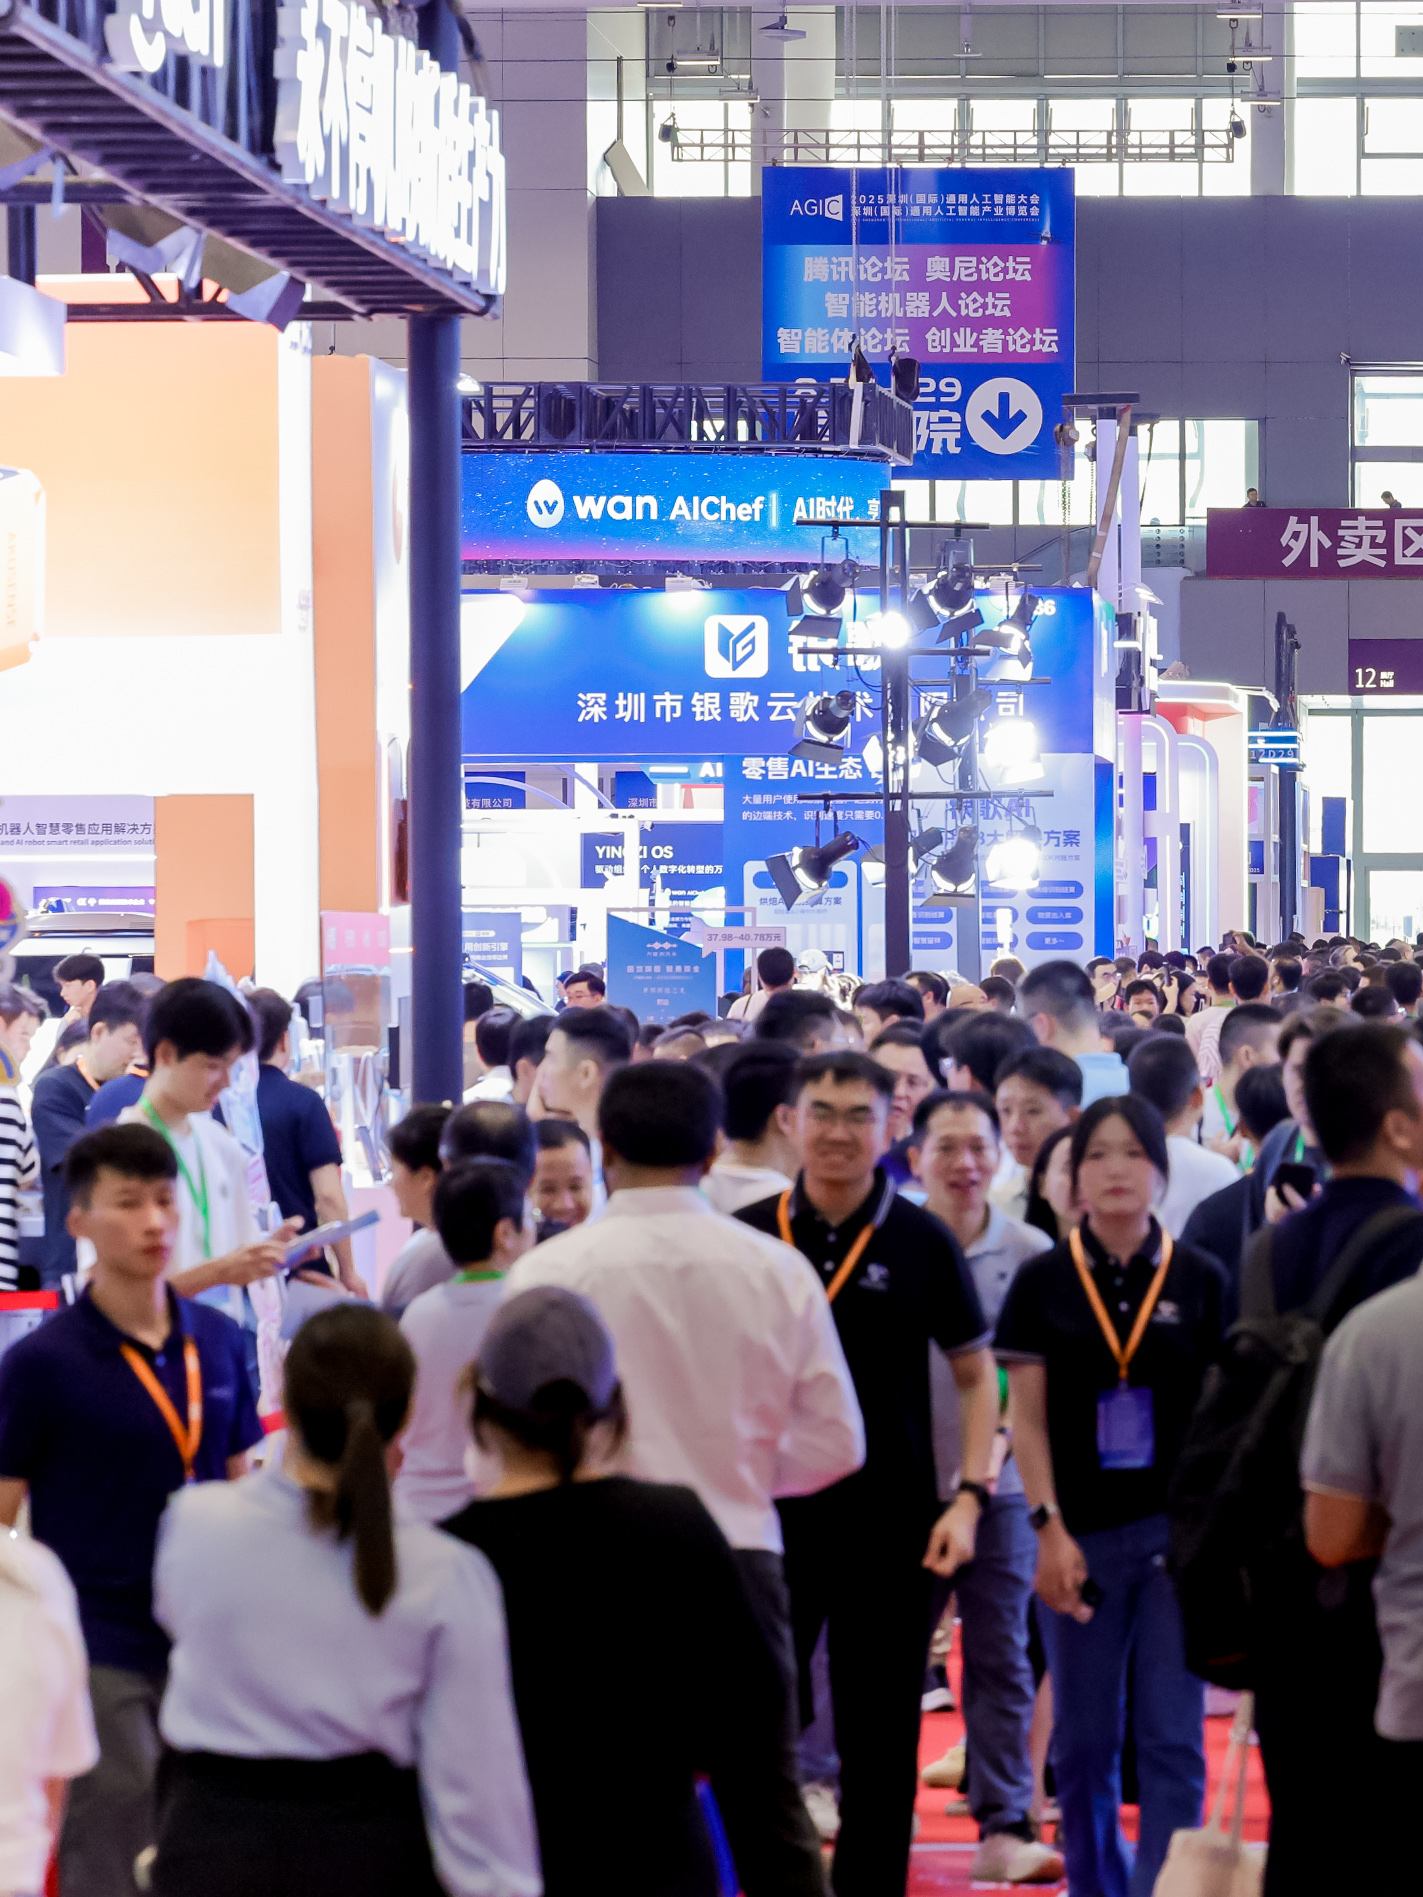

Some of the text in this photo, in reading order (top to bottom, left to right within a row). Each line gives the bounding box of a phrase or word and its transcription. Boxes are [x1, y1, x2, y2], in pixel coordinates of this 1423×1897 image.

[790, 198, 842, 218] AGIC
[803, 256, 1031, 281] 腾讯论坛 奥尼论坛
[825, 292, 1010, 317] 智能机器人论坛
[777, 327, 1058, 353] 智能体论坛 创业者论坛
[573, 495, 658, 520] wan
[670, 496, 764, 521] AIChef
[1355, 668, 1377, 688] 12
[1380, 679, 1394, 688] Hall
[699, 762, 723, 778] AI
[651, 845, 674, 859] OS
